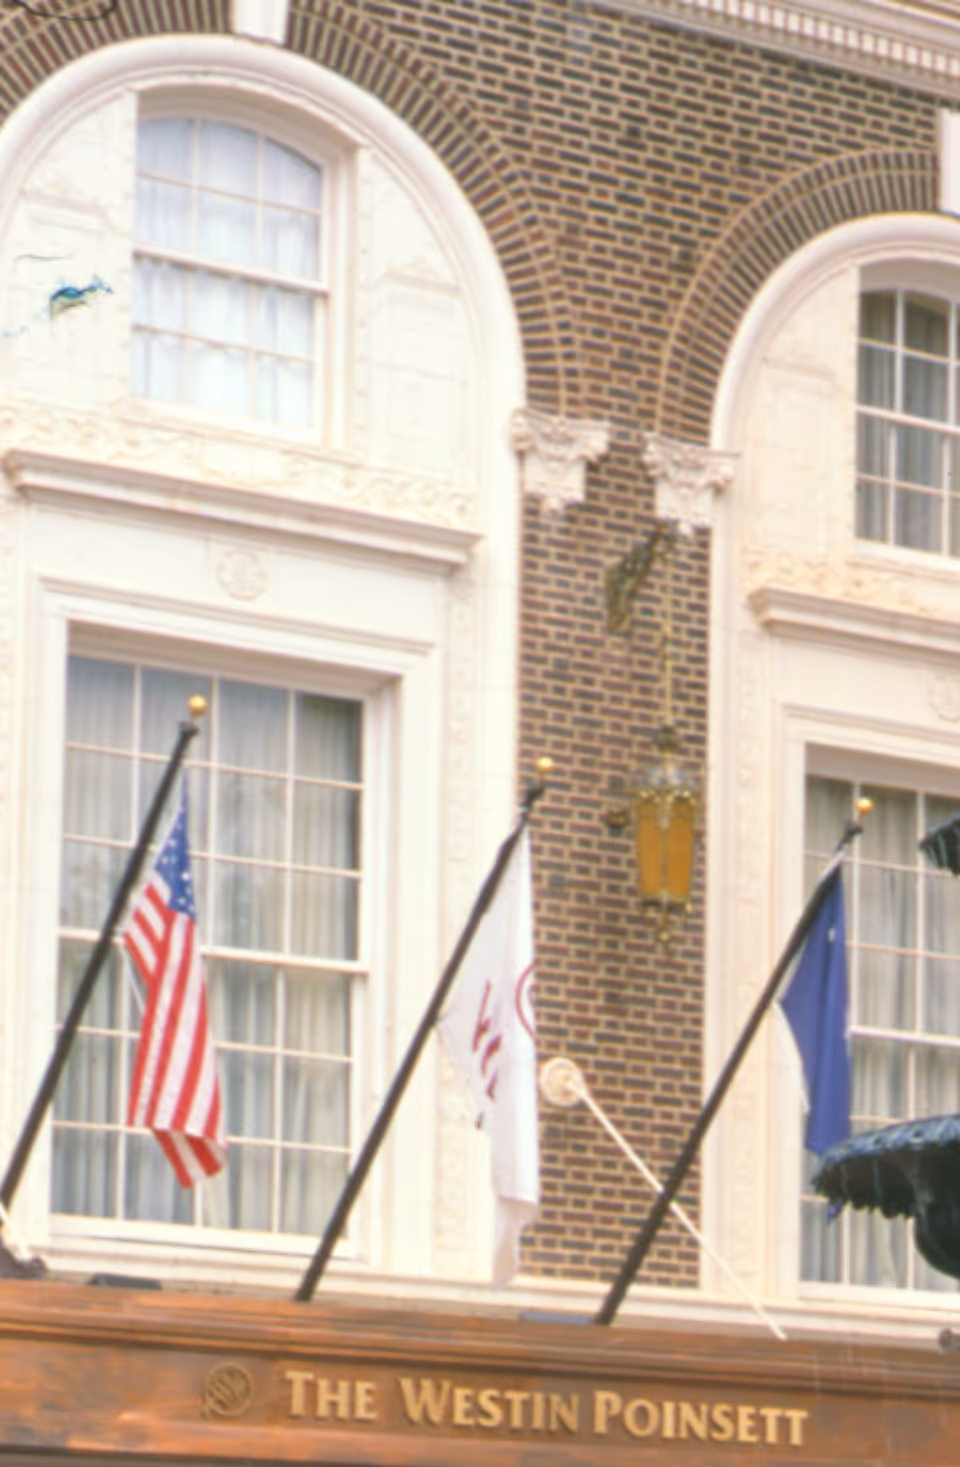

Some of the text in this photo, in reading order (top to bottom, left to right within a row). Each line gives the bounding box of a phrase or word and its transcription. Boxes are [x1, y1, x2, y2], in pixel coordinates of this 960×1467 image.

[285, 1370, 809, 1446] THE WESTIN POINSETT
